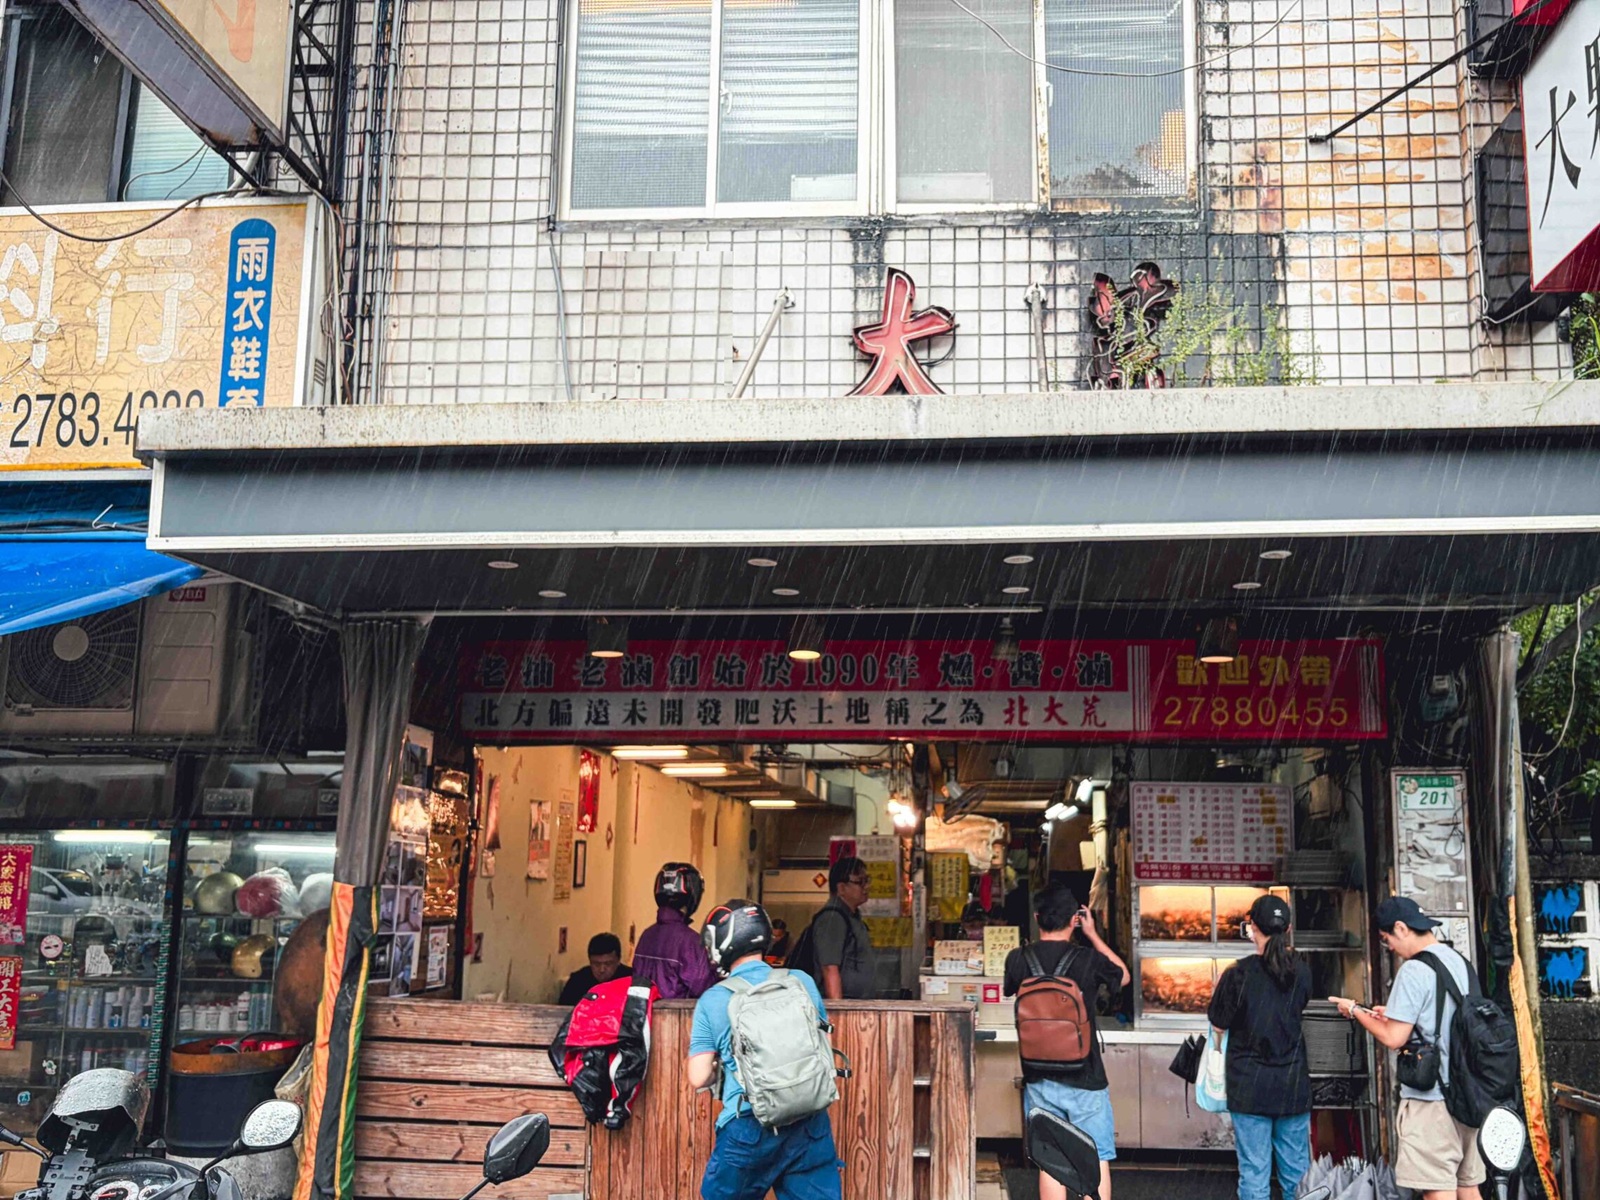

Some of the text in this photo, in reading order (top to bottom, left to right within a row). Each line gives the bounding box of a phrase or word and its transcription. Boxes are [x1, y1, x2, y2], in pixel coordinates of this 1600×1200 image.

[9, 388, 206, 448] 2783.4
[1176, 654, 1332, 687] 歡迎外帶
[1163, 697, 1348, 727] 27880455
[1419, 790, 1448, 805] 201
